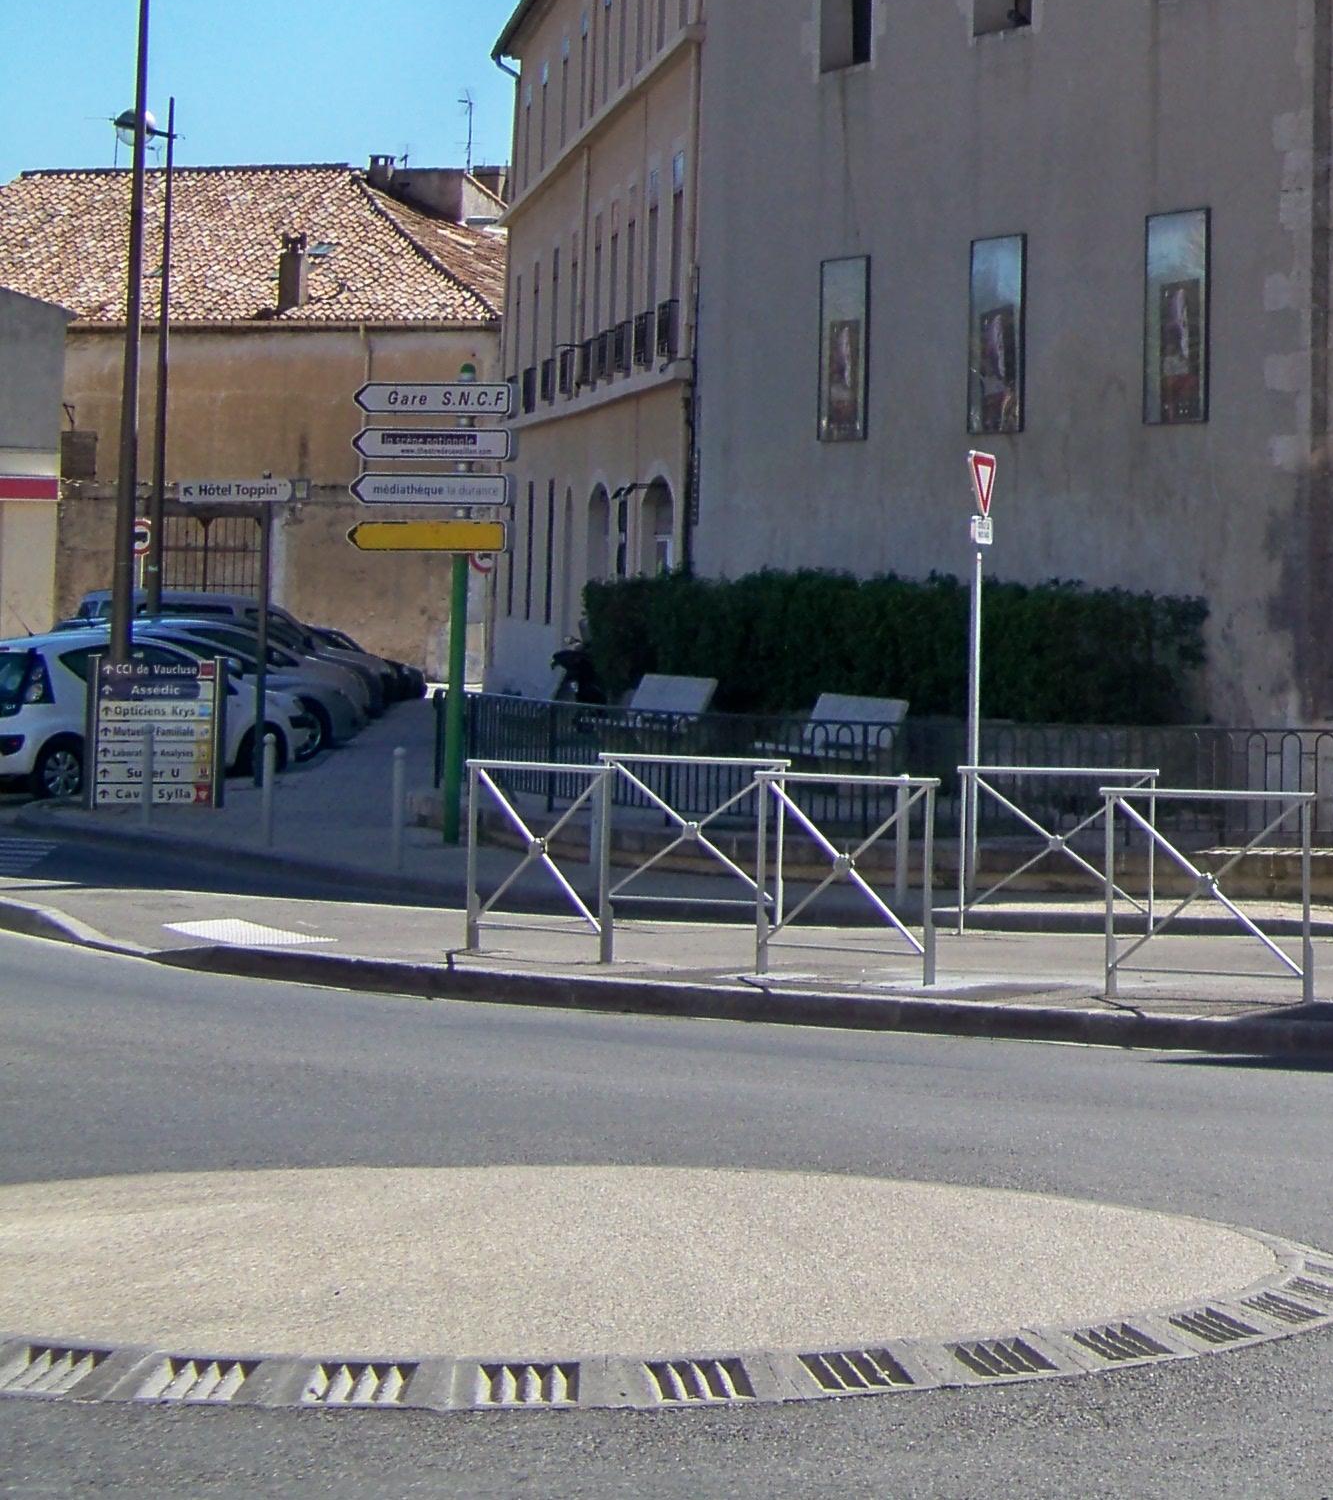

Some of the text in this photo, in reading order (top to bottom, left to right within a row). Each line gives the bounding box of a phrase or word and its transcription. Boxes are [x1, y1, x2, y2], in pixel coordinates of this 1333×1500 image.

[388, 389, 505, 407] Gare S.N.C.F
[426, 434, 475, 446] nationale
[199, 483, 232, 496] Hôtel
[373, 484, 444, 496] médiathèque
[460, 484, 499, 497] durance
[116, 664, 132, 674] CCI
[137, 663, 149, 674] de
[153, 664, 198, 674] Vaucluse
[114, 706, 196, 718] Opticiens Krys
[155, 726, 195, 737] Familiale
[160, 748, 194, 759] Analyses
[127, 767, 180, 778] Suer U
[158, 788, 192, 800] Sylla
